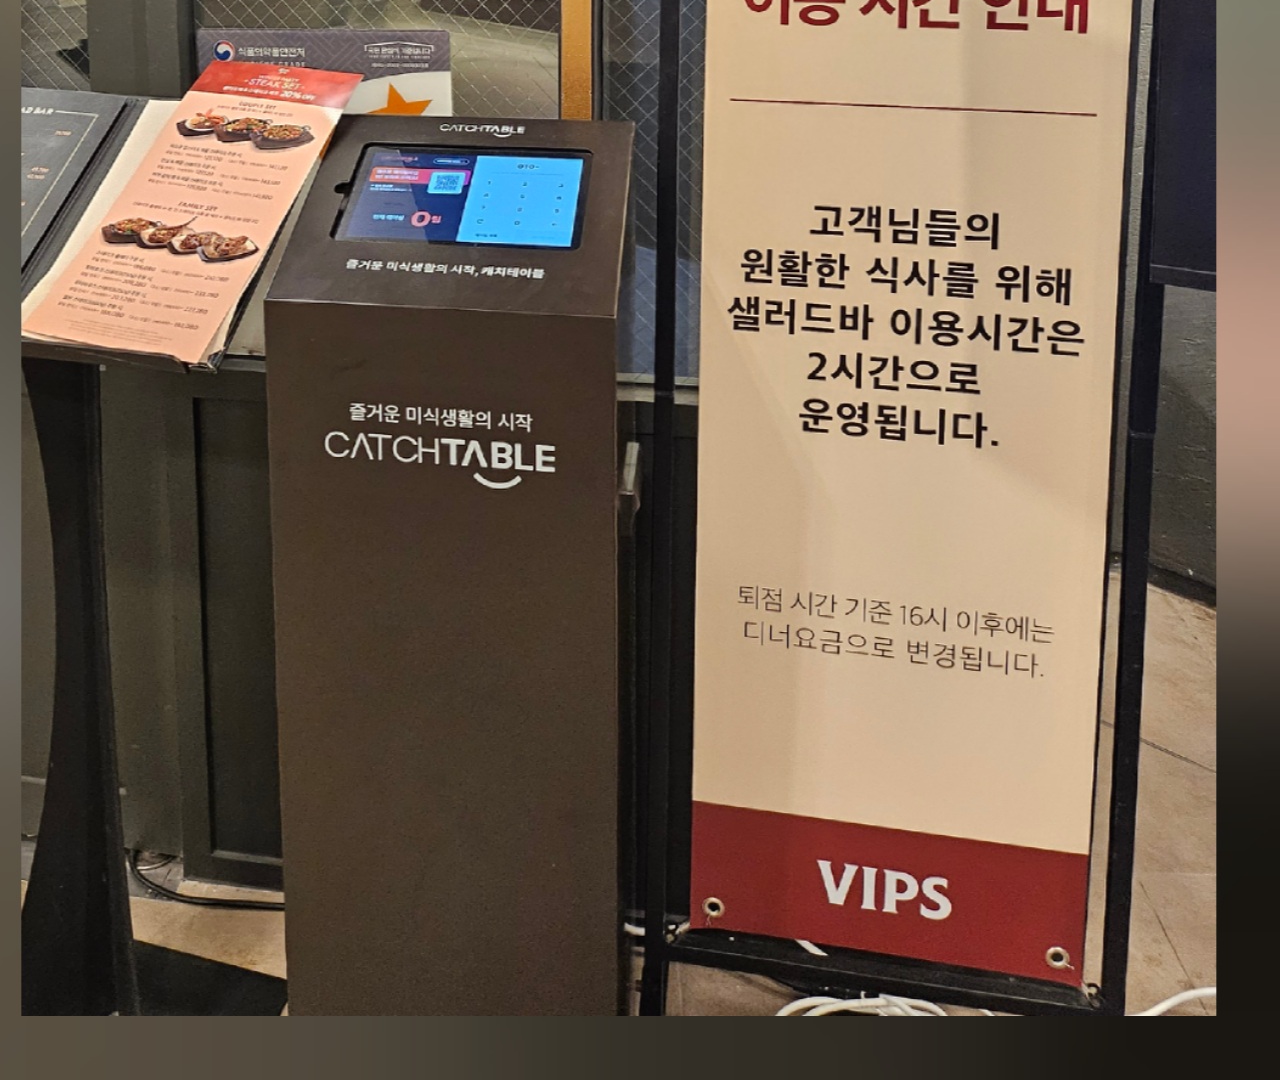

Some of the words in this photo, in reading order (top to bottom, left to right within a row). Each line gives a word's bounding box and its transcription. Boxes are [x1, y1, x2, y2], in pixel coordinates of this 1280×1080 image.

[439, 123, 526, 136] CATCHTABLE
[809, 204, 1000, 250] 고객님들의
[740, 247, 850, 289] 원활한
[865, 256, 980, 298] 식사를
[995, 264, 1073, 306] 위해
[727, 294, 875, 341] 샐러드바
[889, 307, 1085, 357] 이용시간은
[806, 351, 982, 395] 2시간으로
[349, 402, 400, 424] 즐거운
[405, 406, 491, 429] 미식생활의
[497, 412, 533, 433] 시작
[798, 397, 1000, 449] 운영됩니다.
[324, 431, 556, 473] CATCHTABLE
[737, 584, 783, 613] 퇴점
[789, 591, 838, 619] 시간
[844, 596, 893, 626] 기준
[898, 603, 948, 632] 16시
[955, 610, 1056, 644] 이후에는
[742, 620, 896, 660] 디너요금으로
[905, 638, 1045, 679] 변경됩니다.
[817, 859, 953, 921] VIPS
